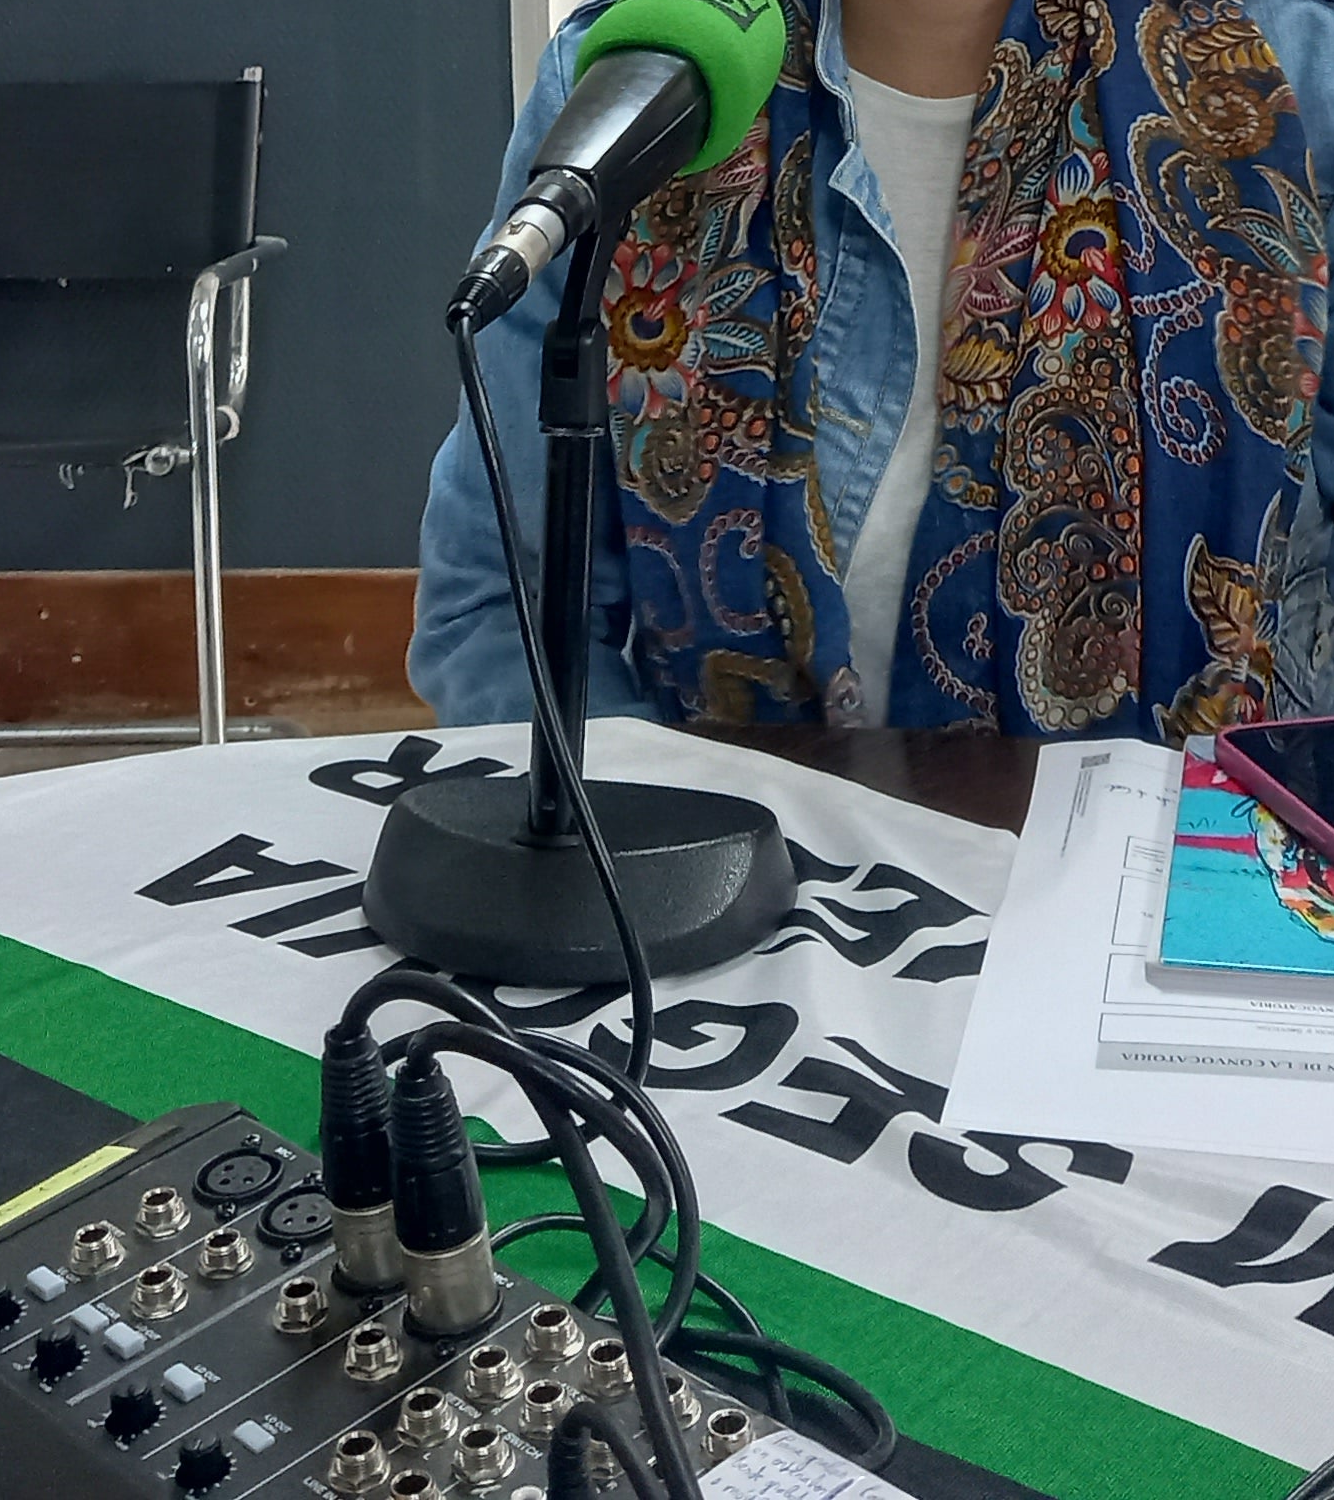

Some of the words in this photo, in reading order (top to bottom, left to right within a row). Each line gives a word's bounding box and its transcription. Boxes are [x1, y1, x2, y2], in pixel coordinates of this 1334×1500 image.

[1120, 1052, 1265, 1068] CONVOCATORIA
[1269, 1059, 1293, 1069] LA
[1301, 1062, 1321, 1071] DE
[504, 1431, 544, 1460] SWITCH
